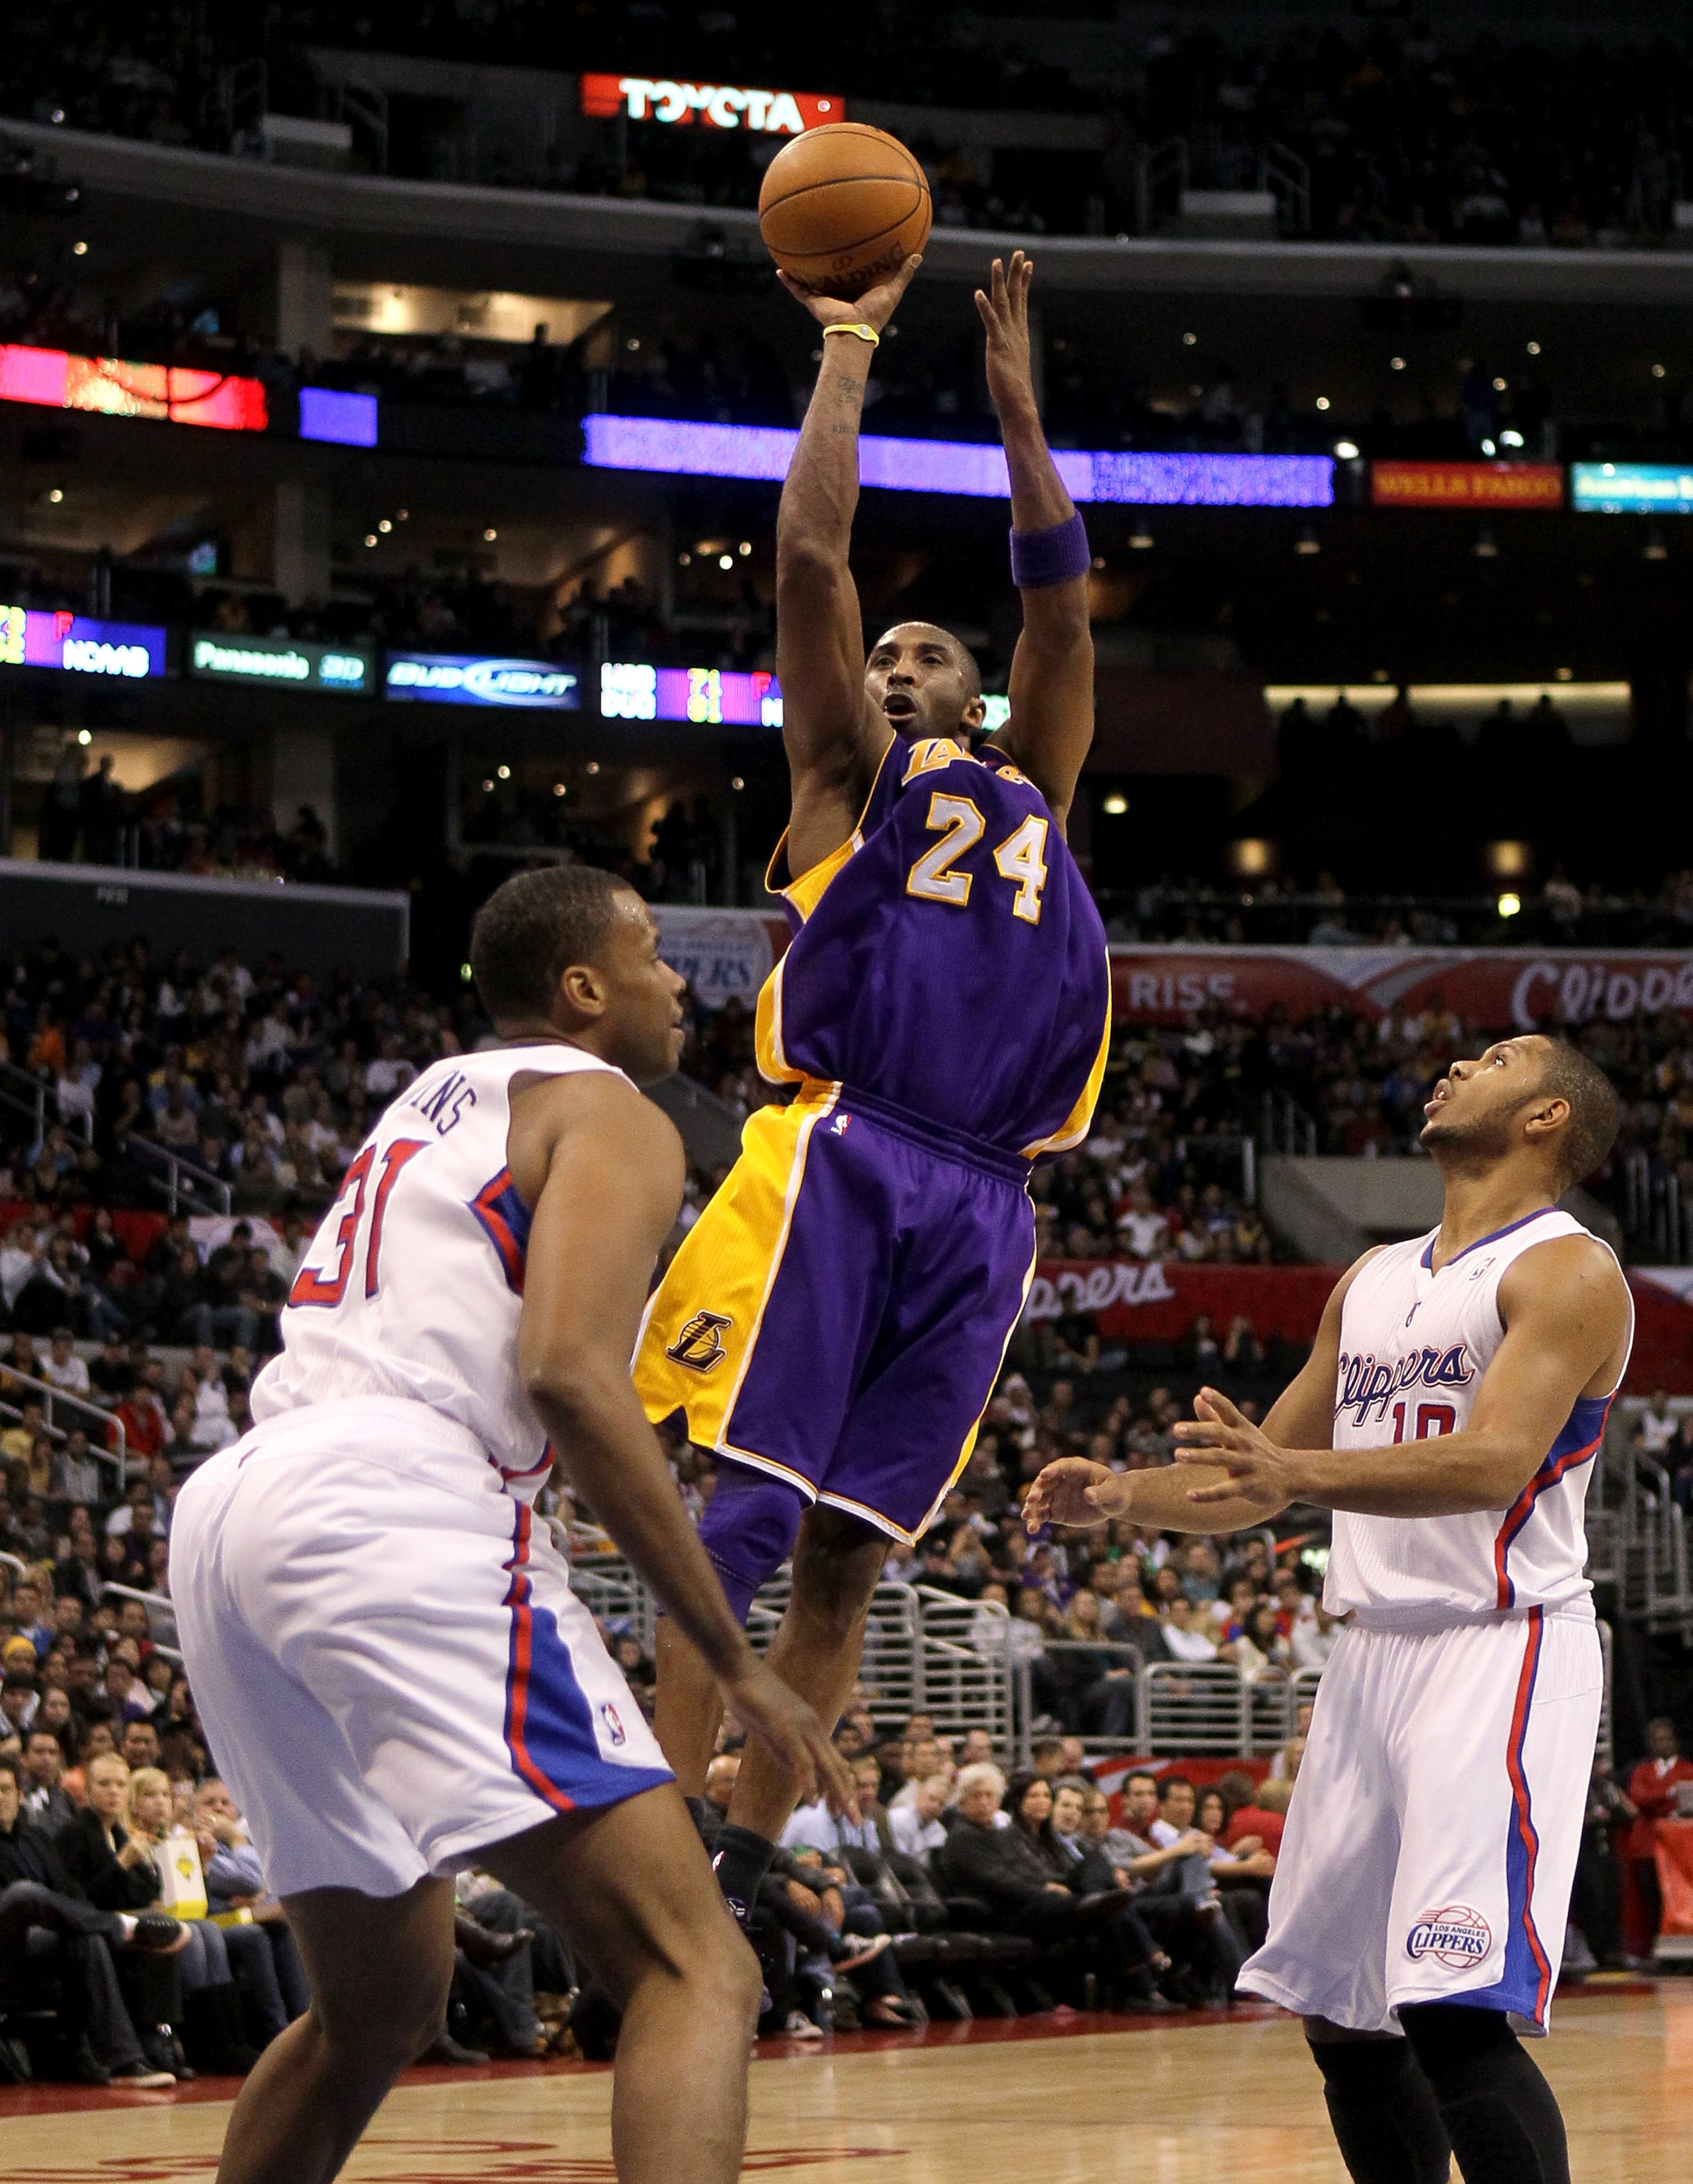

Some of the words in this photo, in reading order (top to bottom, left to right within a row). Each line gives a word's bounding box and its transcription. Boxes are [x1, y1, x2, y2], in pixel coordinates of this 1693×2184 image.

[905, 792, 1049, 925] 24
[1407, 1923, 1484, 1959] CLIPPERS
[1434, 1924, 1450, 1933] LOS
[1450, 1925, 1486, 1937] ANGELES
